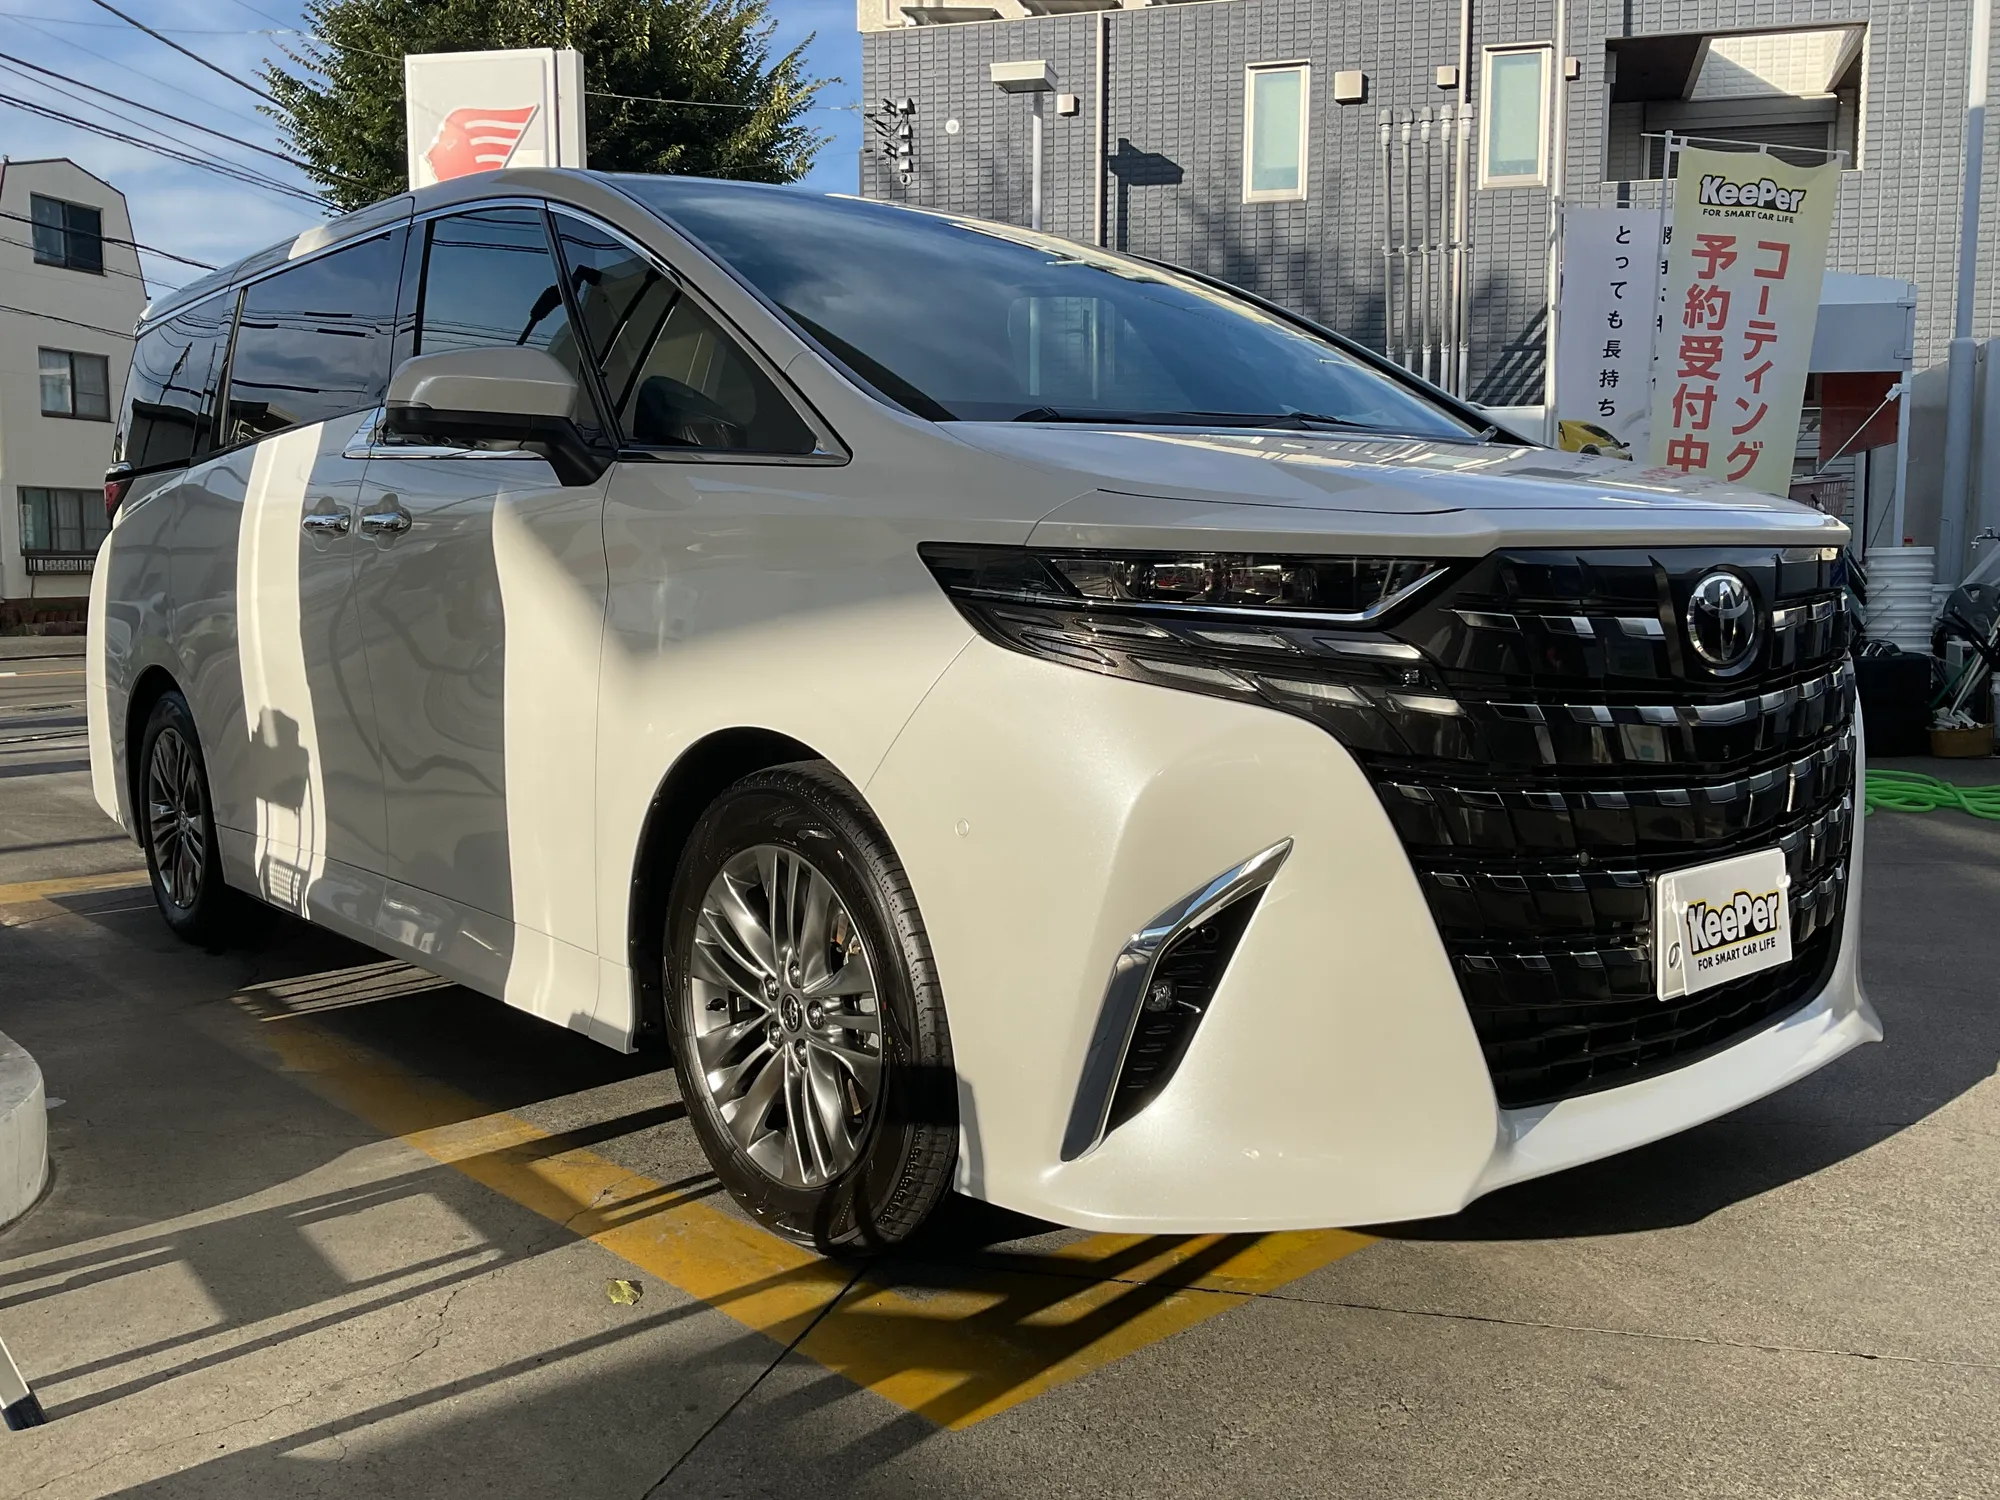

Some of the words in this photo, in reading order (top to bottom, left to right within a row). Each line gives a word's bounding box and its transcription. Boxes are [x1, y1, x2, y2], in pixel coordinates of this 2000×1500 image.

[1699, 174, 1806, 213] KeePer
[1702, 208, 1721, 217] FOR
[1724, 208, 1756, 218] SMART
[1757, 212, 1774, 221] CAR
[1776, 214, 1794, 224] LIFE
[1598, 225, 1631, 417] とっても長持ち
[1666, 233, 1738, 472] 予約受付中
[1727, 240, 1790, 481] コーティング
[1686, 891, 1779, 955] KeePer
[1698, 957, 1714, 971] FOR
[1715, 948, 1740, 966] SMART
[1742, 942, 1757, 957] CAR
[1759, 937, 1776, 952] LIFE
